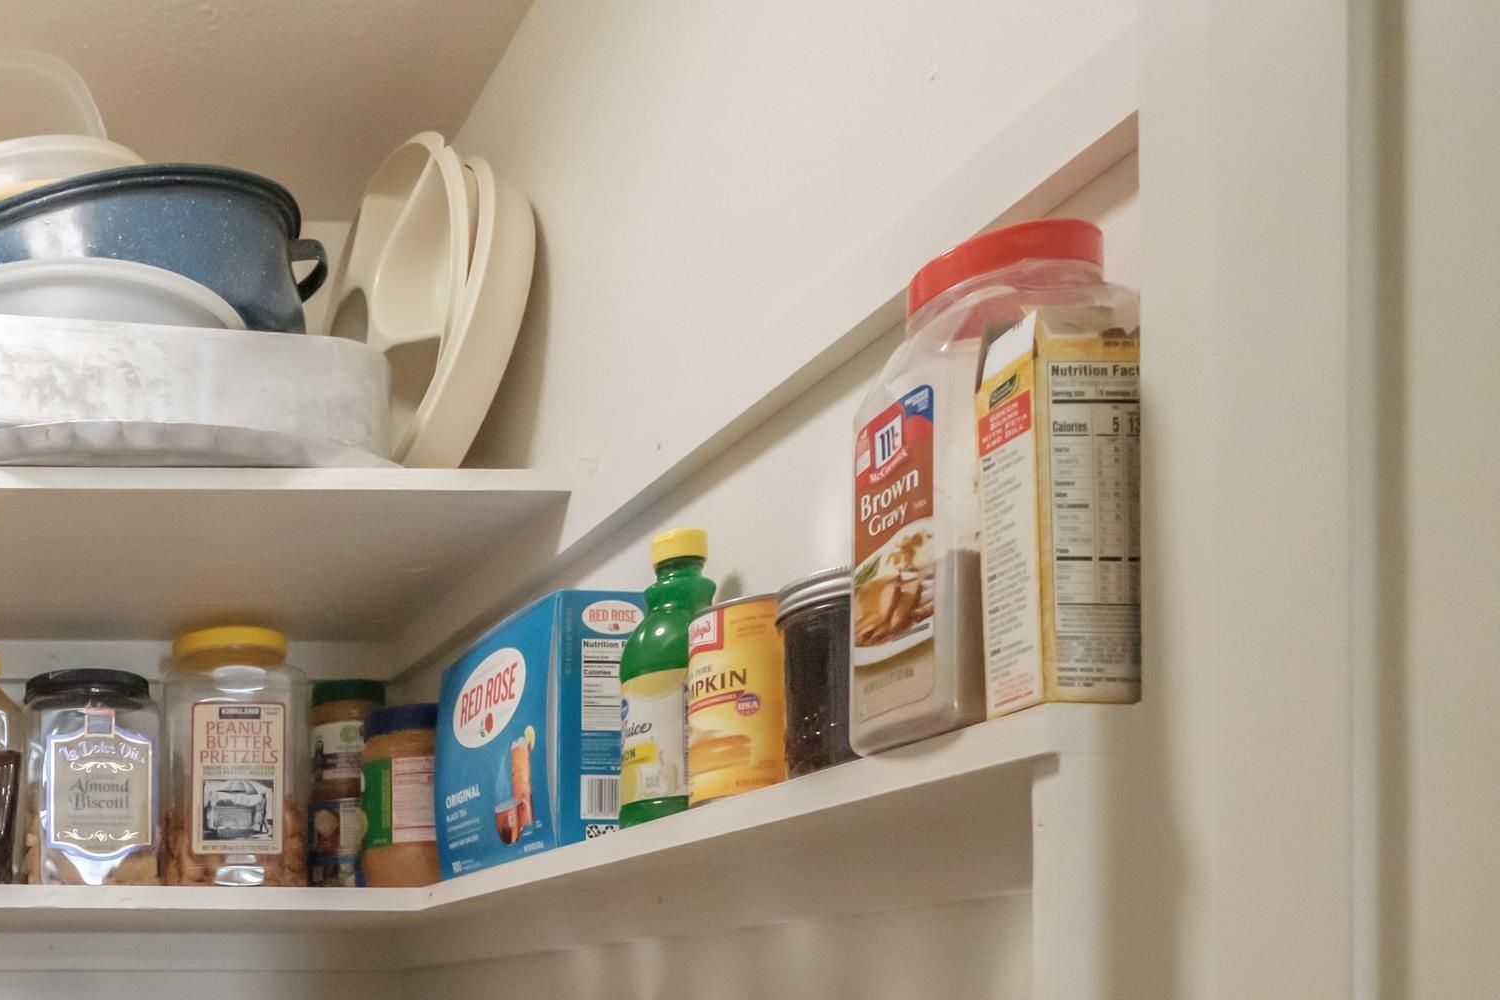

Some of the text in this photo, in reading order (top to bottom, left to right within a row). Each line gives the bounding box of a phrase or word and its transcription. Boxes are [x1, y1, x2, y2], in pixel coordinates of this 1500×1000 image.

[1051, 364, 1140, 377] Nutrition Fact
[988, 402, 1019, 422] GREEN
[989, 410, 1020, 431] BEANS
[1052, 420, 1088, 433] Calories
[1112, 417, 1120, 432] 5
[982, 413, 1028, 445] WITH FETA
[985, 424, 1024, 450] AND DILL
[869, 449, 909, 484] McCormick
[861, 468, 919, 522] Brown
[868, 500, 909, 537] Gravy
[589, 608, 637, 624] RED ROSE
[583, 640, 619, 650] Nutrition
[460, 662, 519, 728] RED ROSE
[221, 707, 260, 715] KIRKLAND
[738, 700, 759, 711] USA
[205, 721, 273, 735] PEANUT
[78, 741, 116, 757] Dolce
[206, 736, 273, 749] BUTTER
[200, 750, 279, 764] PRETZELS
[69, 779, 130, 793] Almond
[69, 793, 130, 811] Biscotti
[445, 783, 481, 809] ORIGINAL
